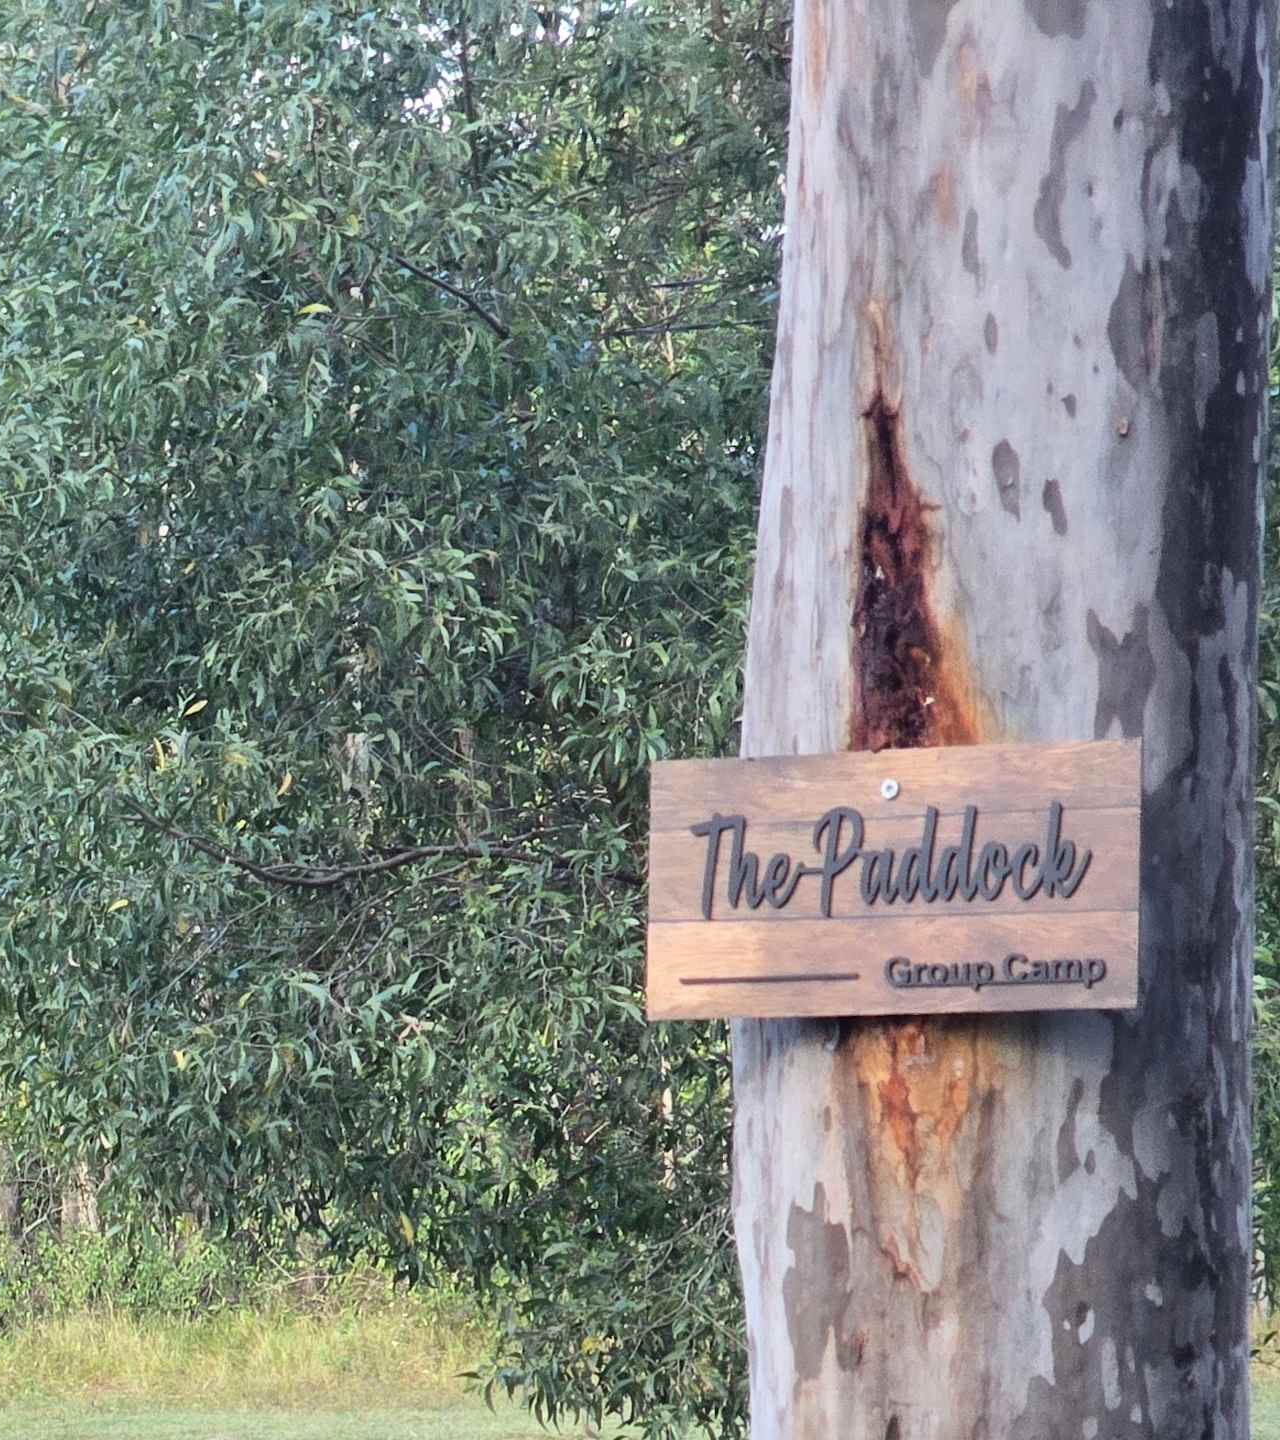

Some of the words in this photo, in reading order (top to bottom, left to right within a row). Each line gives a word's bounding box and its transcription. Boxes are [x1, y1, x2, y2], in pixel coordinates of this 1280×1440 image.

[691, 812, 808, 920] The
[812, 801, 1093, 919] Paddock
[882, 956, 994, 991] Group
[1001, 952, 1107, 989] Camp
